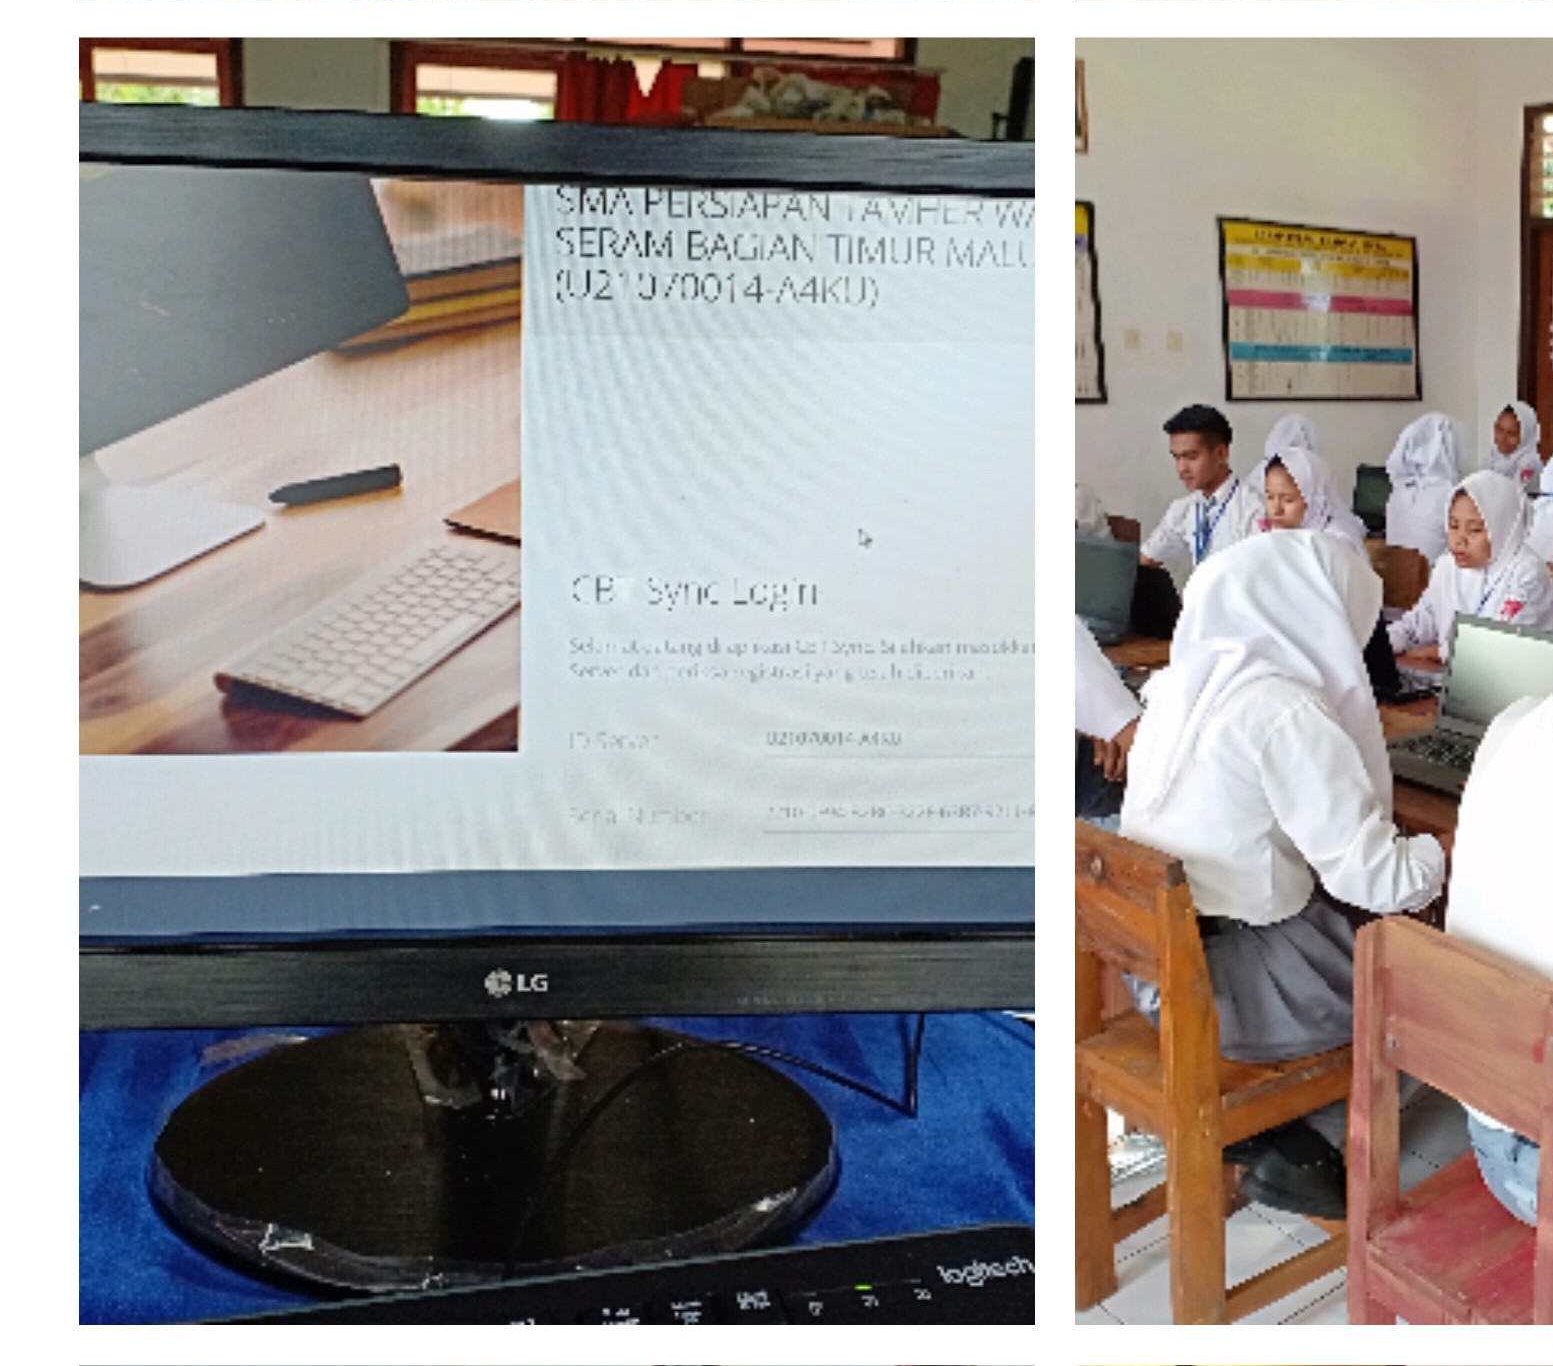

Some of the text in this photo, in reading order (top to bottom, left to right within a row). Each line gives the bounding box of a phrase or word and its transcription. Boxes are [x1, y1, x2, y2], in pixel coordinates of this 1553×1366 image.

[556, 185, 634, 216] SMA
[644, 188, 831, 223] PERSIAPAN
[556, 227, 674, 259] SERAM
[687, 230, 815, 263] BAGIAN
[828, 234, 936, 266] TIMUR
[572, 575, 818, 612] CB Sync Login
[517, 973, 548, 992] LG
[936, 1255, 1035, 1287] logitech
